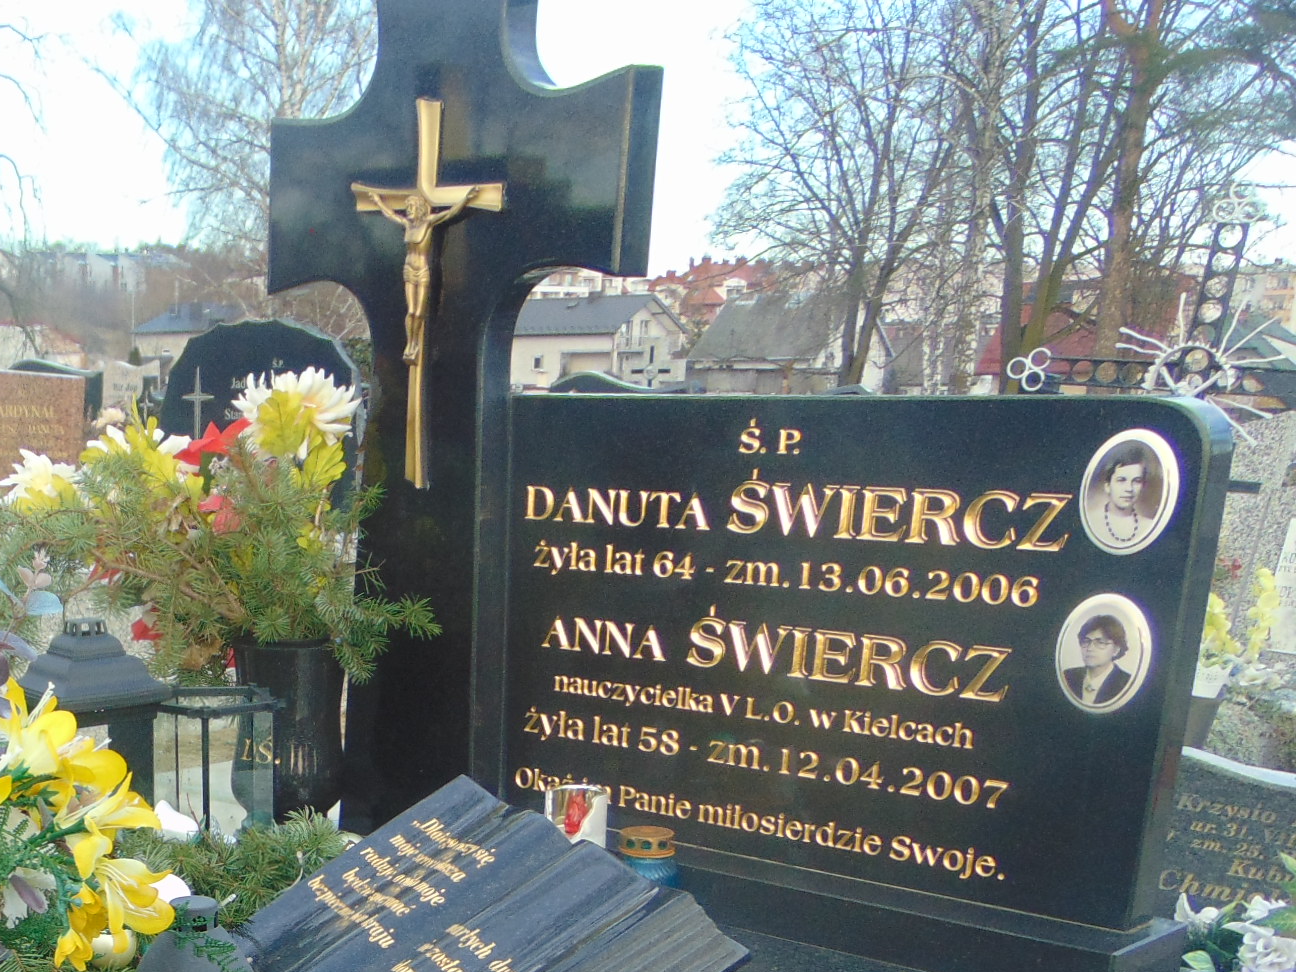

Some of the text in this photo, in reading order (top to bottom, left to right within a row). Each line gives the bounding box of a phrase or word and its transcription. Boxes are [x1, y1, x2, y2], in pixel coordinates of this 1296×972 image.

[738, 417, 801, 455] Ś. P.
[524, 467, 1073, 552] DANUTA ŚWIERCZ
[533, 539, 596, 575] żyła
[604, 544, 645, 576] lat
[653, 550, 696, 580] 64
[541, 603, 1013, 702] ANNA ŚWIERCZ
[523, 704, 585, 741] żyła
[592, 715, 631, 748] lat
[638, 726, 681, 756] 58
[554, 673, 974, 749] nauczycielka V L.O. w Kielcach
[389, 834, 422, 858] moje
[619, 785, 692, 819] Panie
[697, 802, 883, 856] miłosierdzie
[889, 835, 1006, 881] Swoje.
[413, 881, 447, 907] moje
